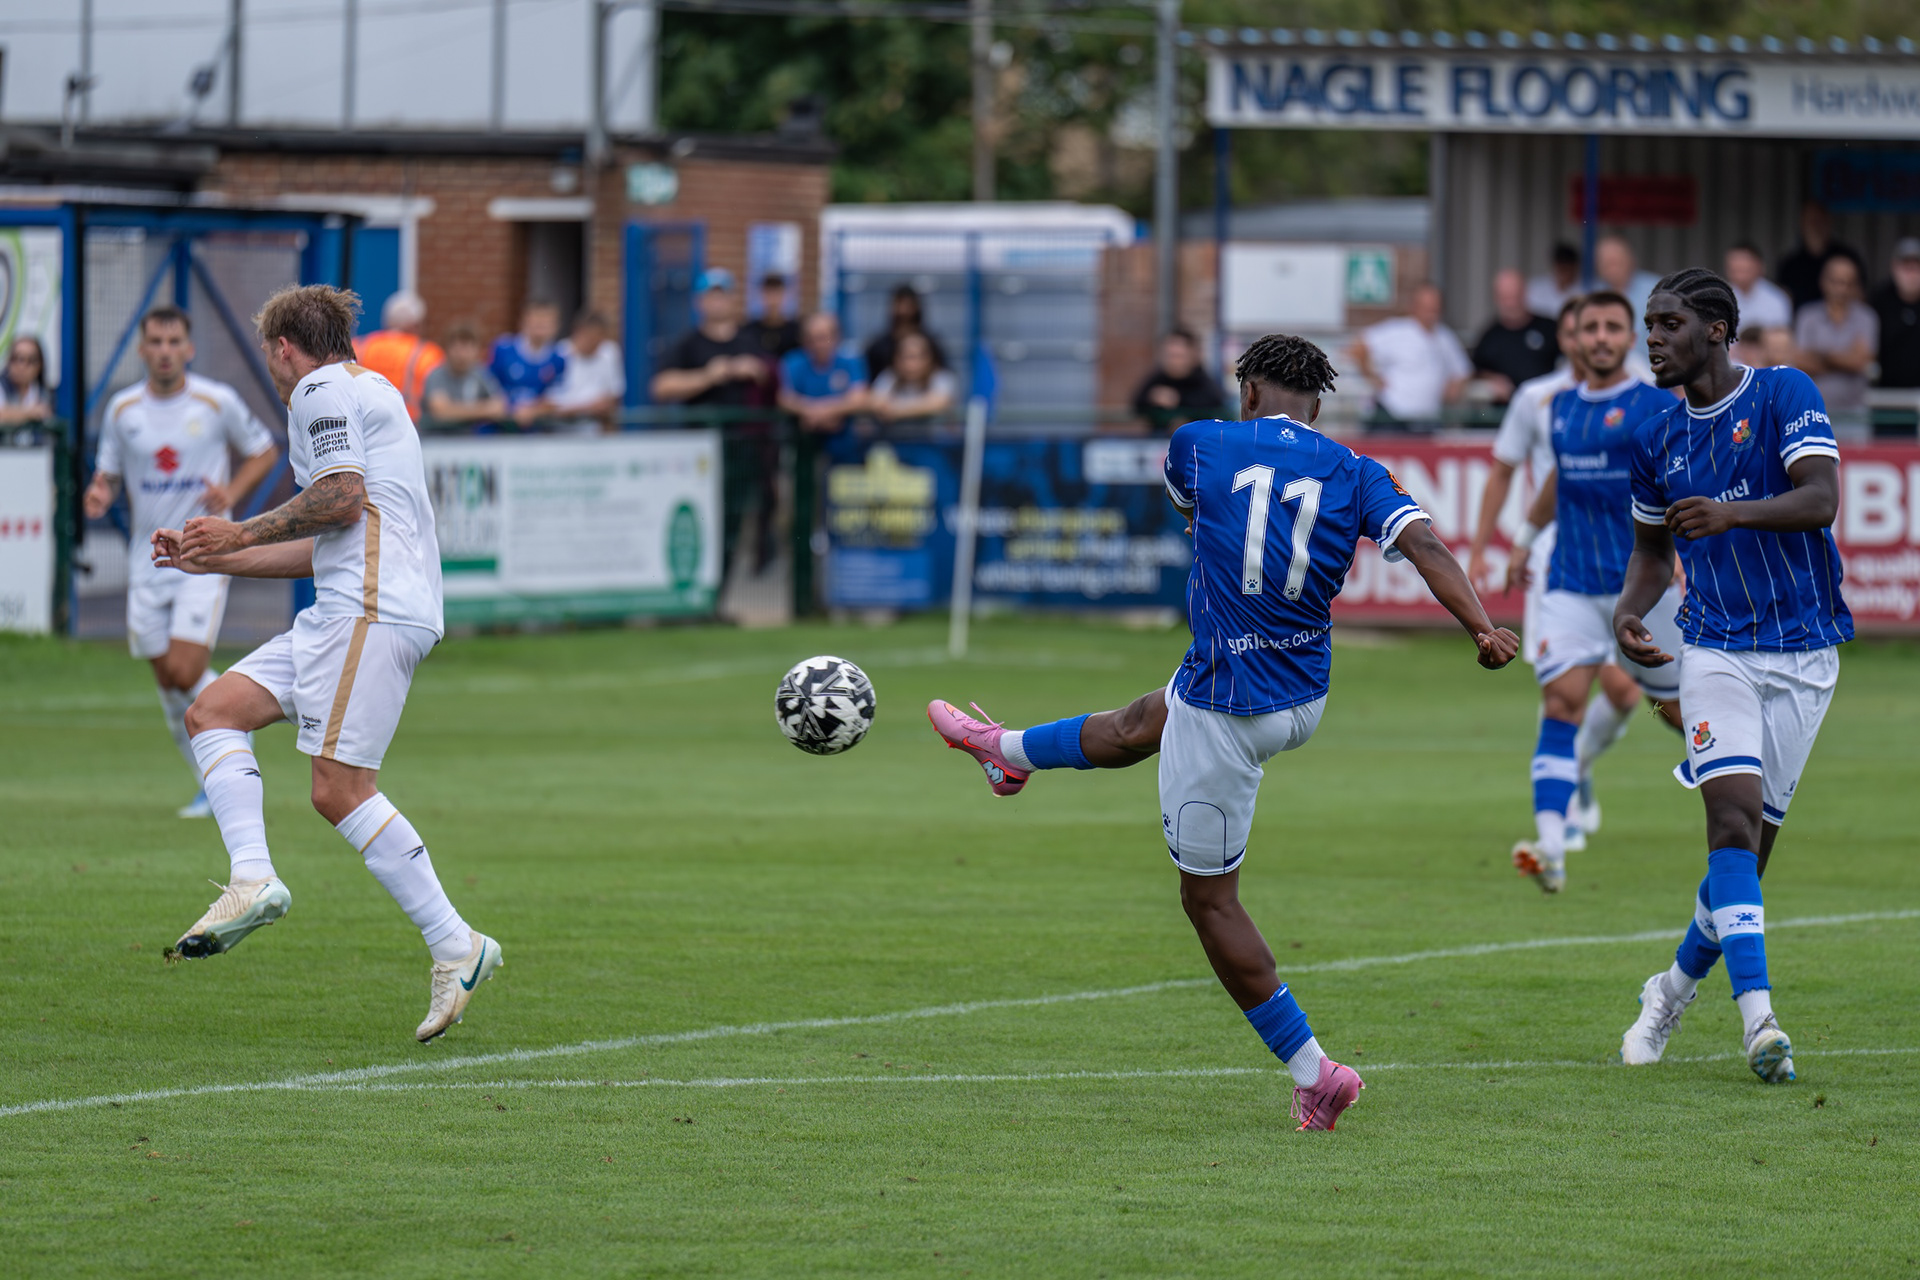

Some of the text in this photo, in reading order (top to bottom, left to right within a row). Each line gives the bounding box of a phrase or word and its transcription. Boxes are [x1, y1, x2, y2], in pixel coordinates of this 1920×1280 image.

[1231, 64, 1753, 123] NAGLE FLOORING
[312, 431, 348, 447] STADIUM
[313, 438, 349, 454] SUPPORT
[314, 444, 350, 460] SERVICES
[1231, 464, 1323, 601] 11
